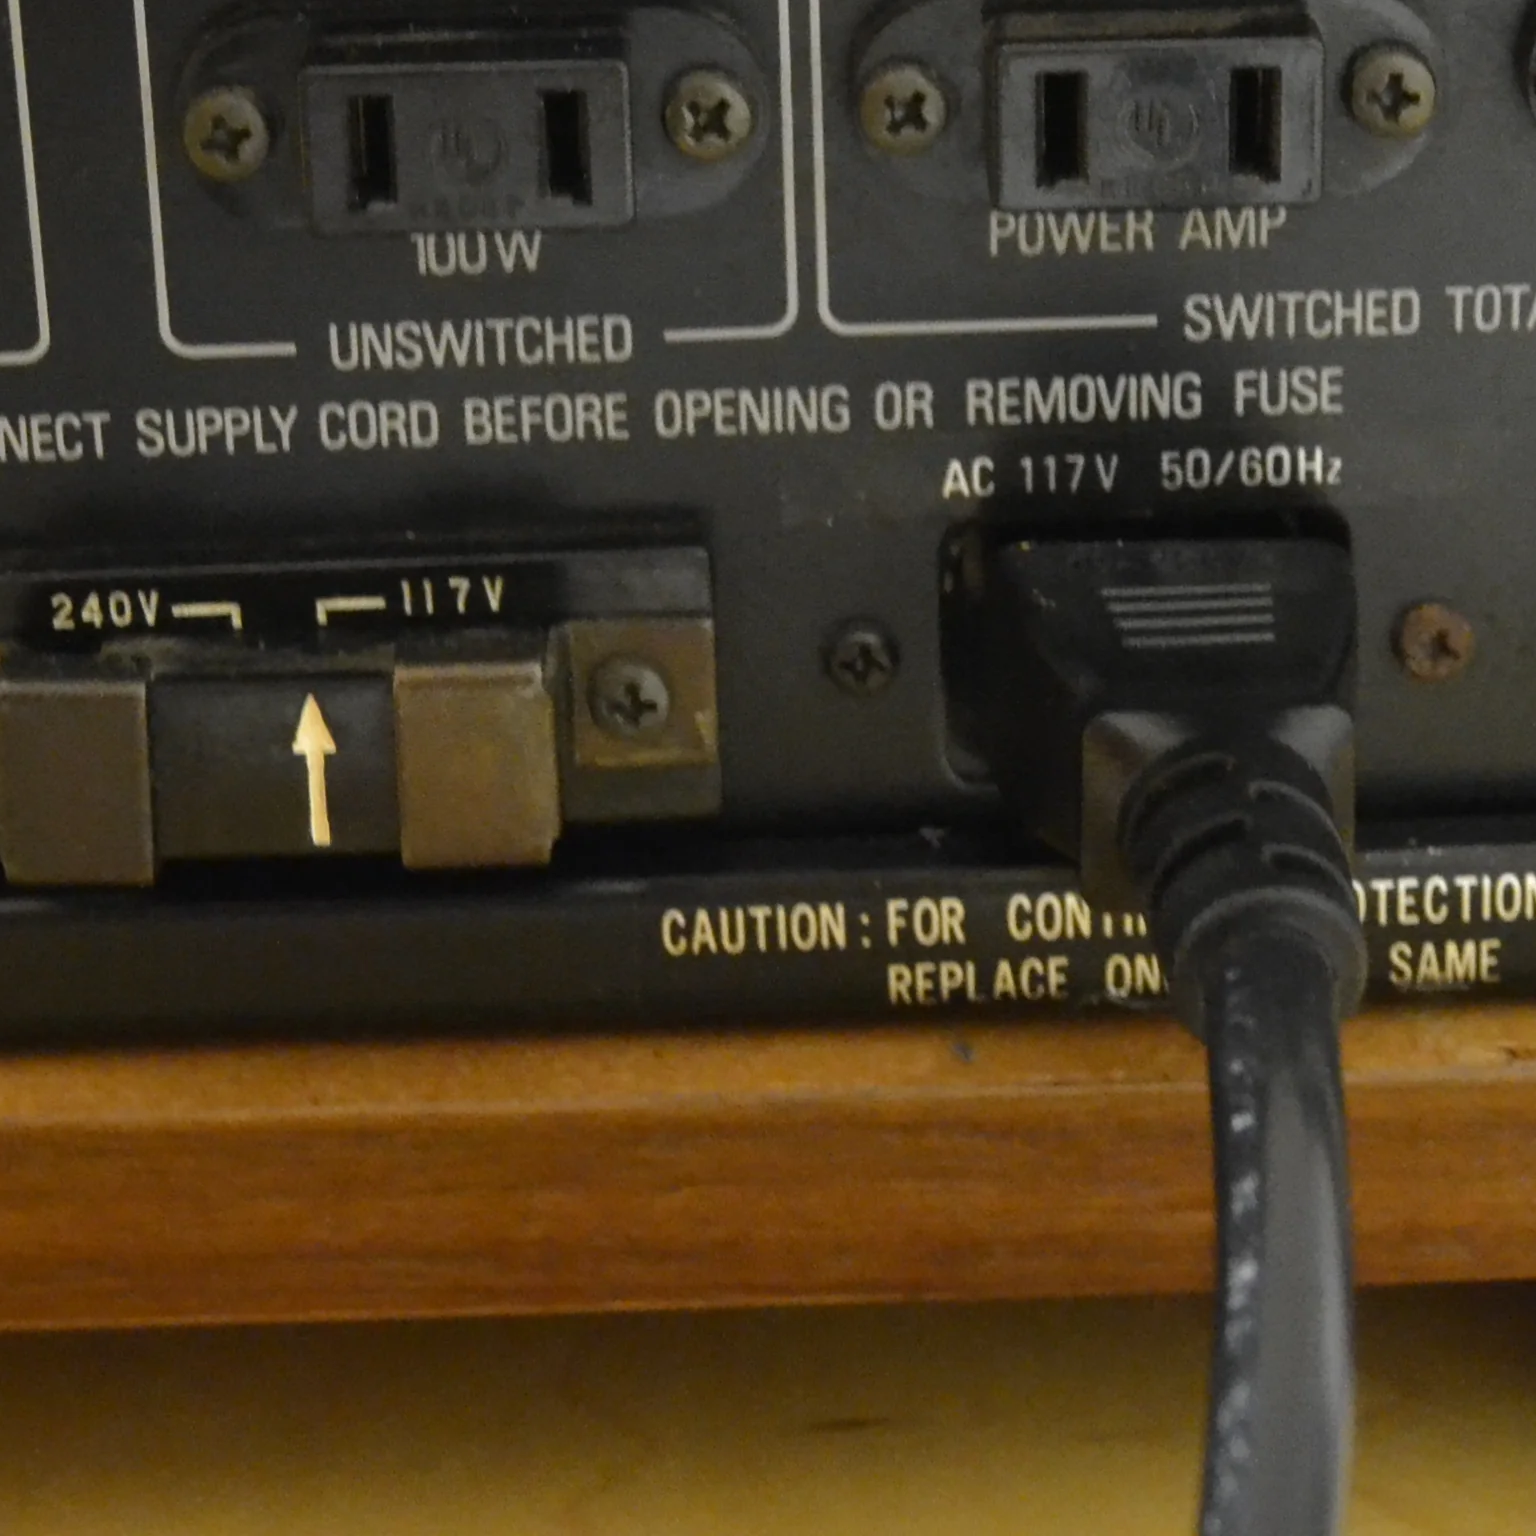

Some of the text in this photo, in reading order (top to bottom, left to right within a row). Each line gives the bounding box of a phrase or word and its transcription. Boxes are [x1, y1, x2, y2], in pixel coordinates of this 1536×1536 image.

[410, 229, 542, 278] 100W
[989, 206, 1288, 259] POWER AMP
[1184, 287, 1421, 341] SWITCHED
[328, 314, 634, 371] UNSWITCHED
[135, 405, 298, 457] SUPPLY
[318, 400, 440, 451] CORD
[463, 392, 629, 445] BEFORE
[654, 384, 851, 438] OPENING
[874, 381, 934, 430] OR
[965, 371, 1203, 426] REMOVING
[1235, 365, 1344, 415] FUSE
[942, 443, 1345, 499] AC 117V 50/60Hz
[51, 589, 159, 630] 240V
[400, 576, 504, 616] 117V
[886, 896, 966, 946] FOR
[887, 958, 1069, 1004] REPLACE
[1389, 937, 1500, 988] SAME
